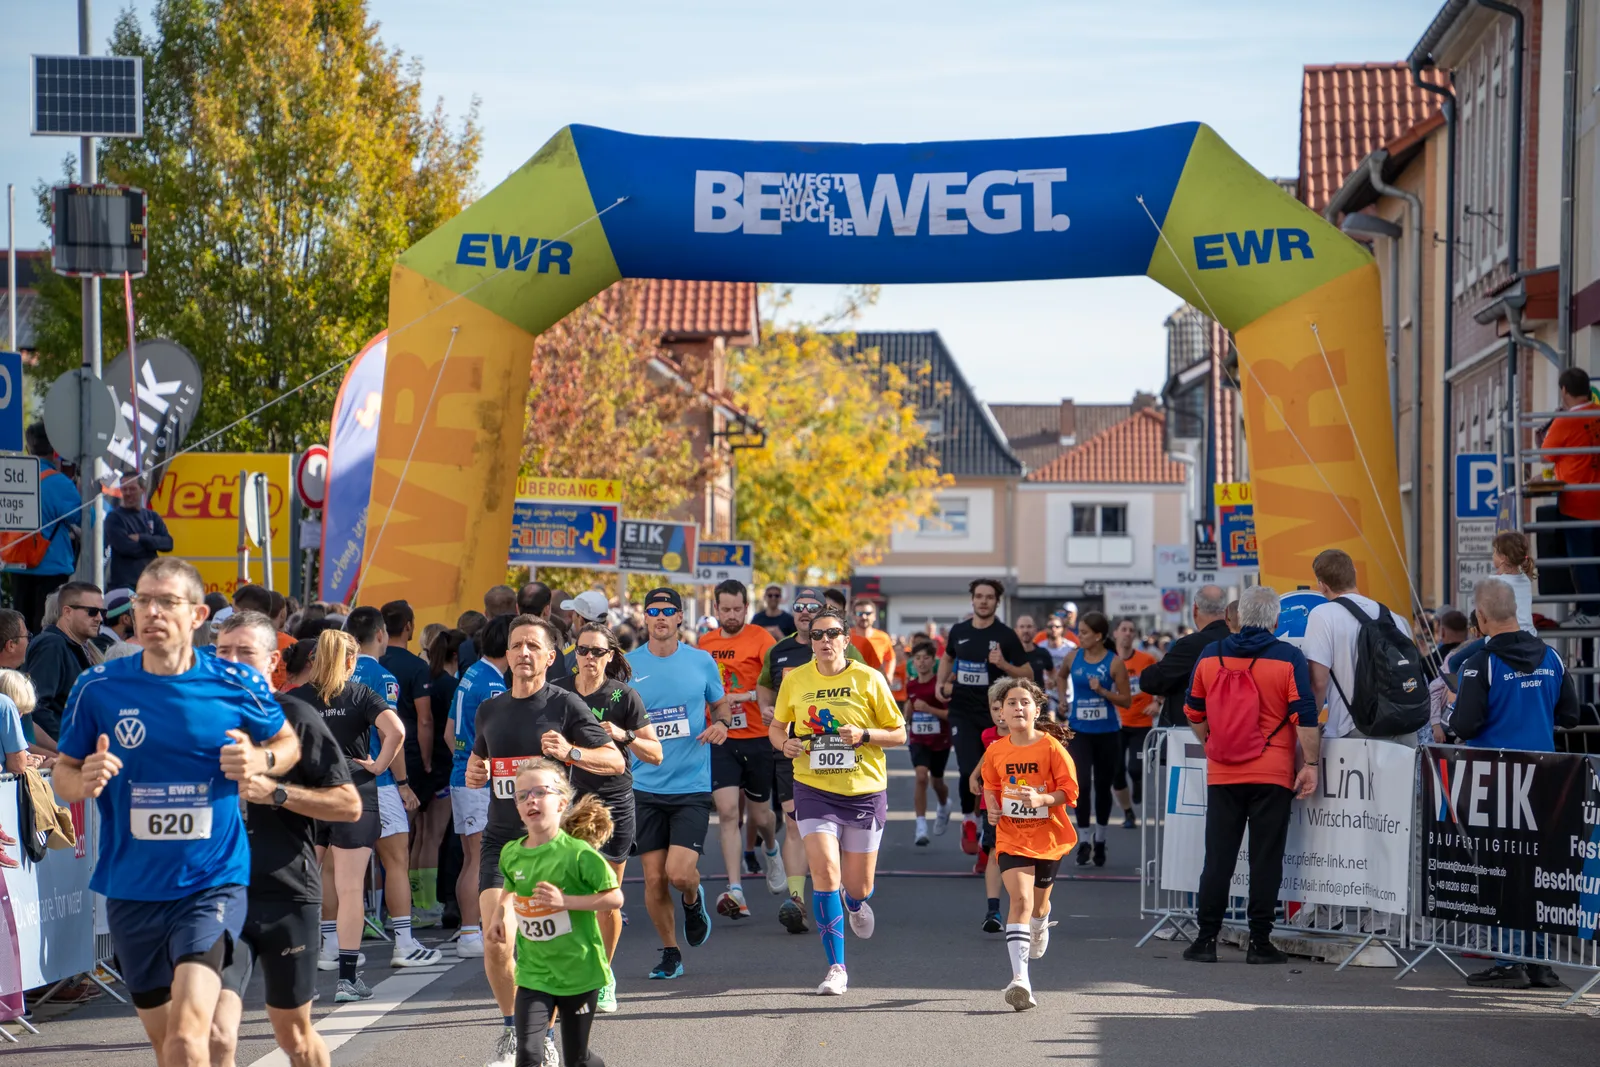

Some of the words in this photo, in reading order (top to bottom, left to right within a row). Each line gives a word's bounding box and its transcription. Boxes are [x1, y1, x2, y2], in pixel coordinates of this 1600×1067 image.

[779, 187, 829, 206] WAS
[780, 204, 835, 223] EUCH
[828, 217, 854, 236] BE
[455, 233, 573, 275] EWR
[1193, 228, 1315, 271] EWR
[4, 467, 28, 485] Std.
[517, 477, 598, 498] ÜBERGANG
[1469, 461, 1498, 511] P
[0, 496, 24, 511] tags
[5, 513, 24, 525] Uhr
[619, 522, 665, 545] EIK
[711, 650, 736, 659] EWR
[963, 674, 981, 684] 607
[1503, 672, 1515, 681] SC
[815, 686, 852, 700] EWR
[118, 707, 140, 717] JAKO
[1082, 711, 1101, 719] 570
[656, 723, 680, 738] 624
[818, 752, 845, 766] 902
[1006, 762, 1039, 775] EWR
[497, 779, 517, 797] 10
[1322, 757, 1376, 801] Link
[168, 785, 196, 796] EWR
[148, 813, 194, 836] 620
[1428, 831, 1539, 857] BAUFERTIGTEILE
[1283, 851, 1368, 871] ter.pfeiffer-link.net
[1232, 873, 1250, 886] 0615
[522, 918, 557, 938] 230
